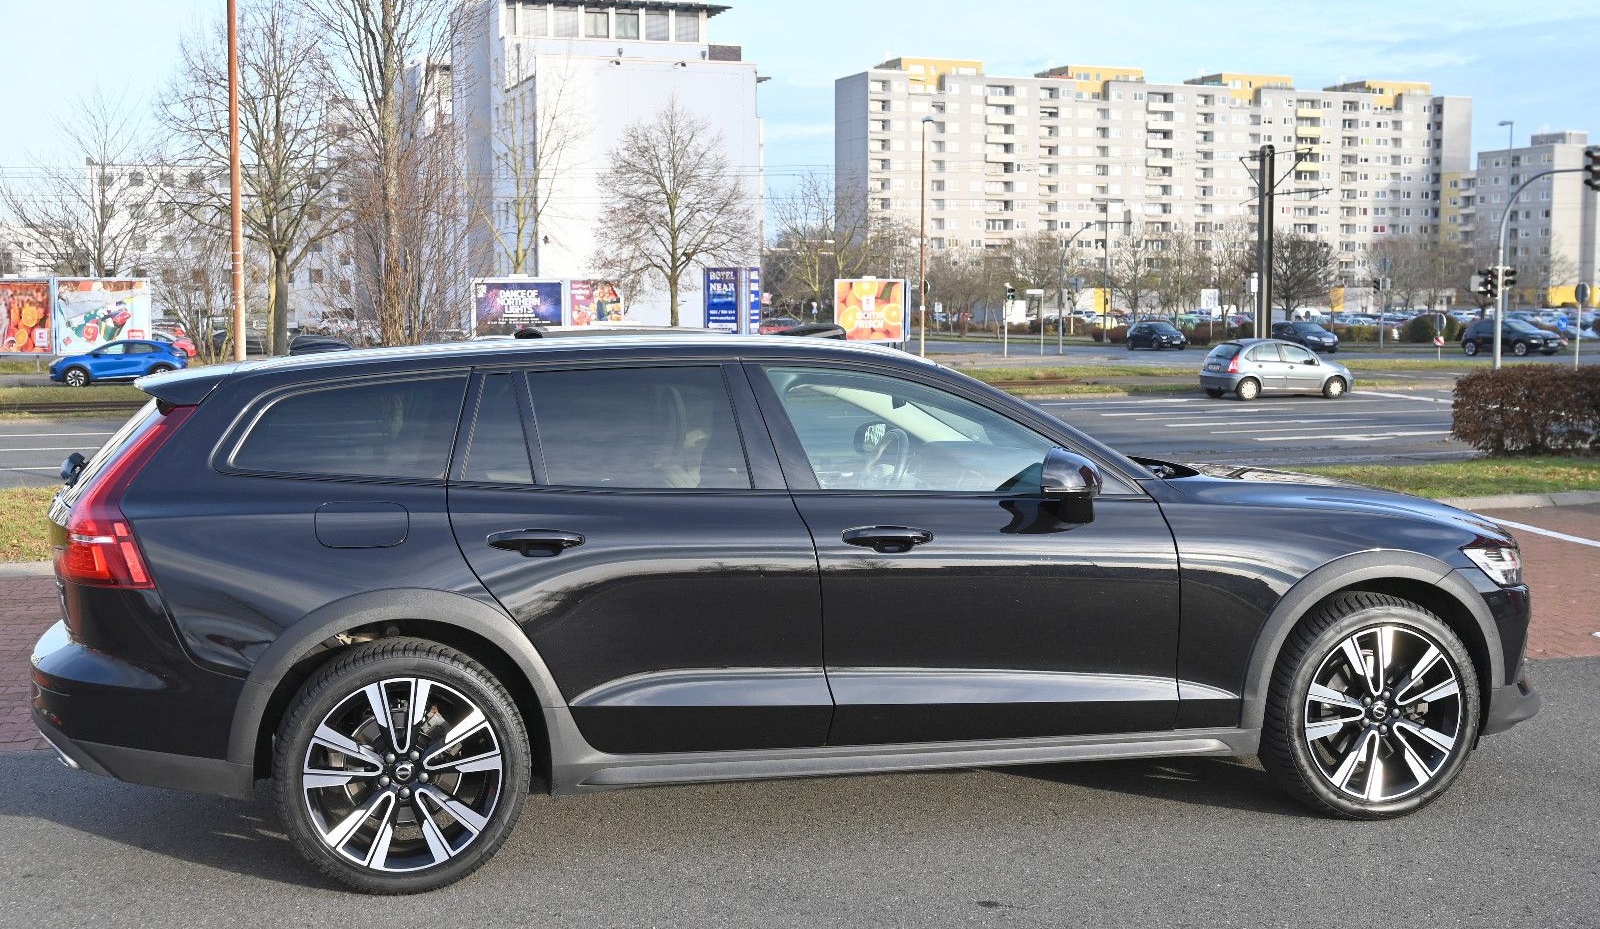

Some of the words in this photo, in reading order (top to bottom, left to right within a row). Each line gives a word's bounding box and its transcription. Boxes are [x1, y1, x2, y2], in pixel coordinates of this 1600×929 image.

[709, 271, 735, 280] HOTEL
[499, 289, 526, 298] DANCE
[527, 289, 539, 298] OF
[496, 297, 541, 306] NORTHERN
[504, 305, 534, 314] LIGHTS
